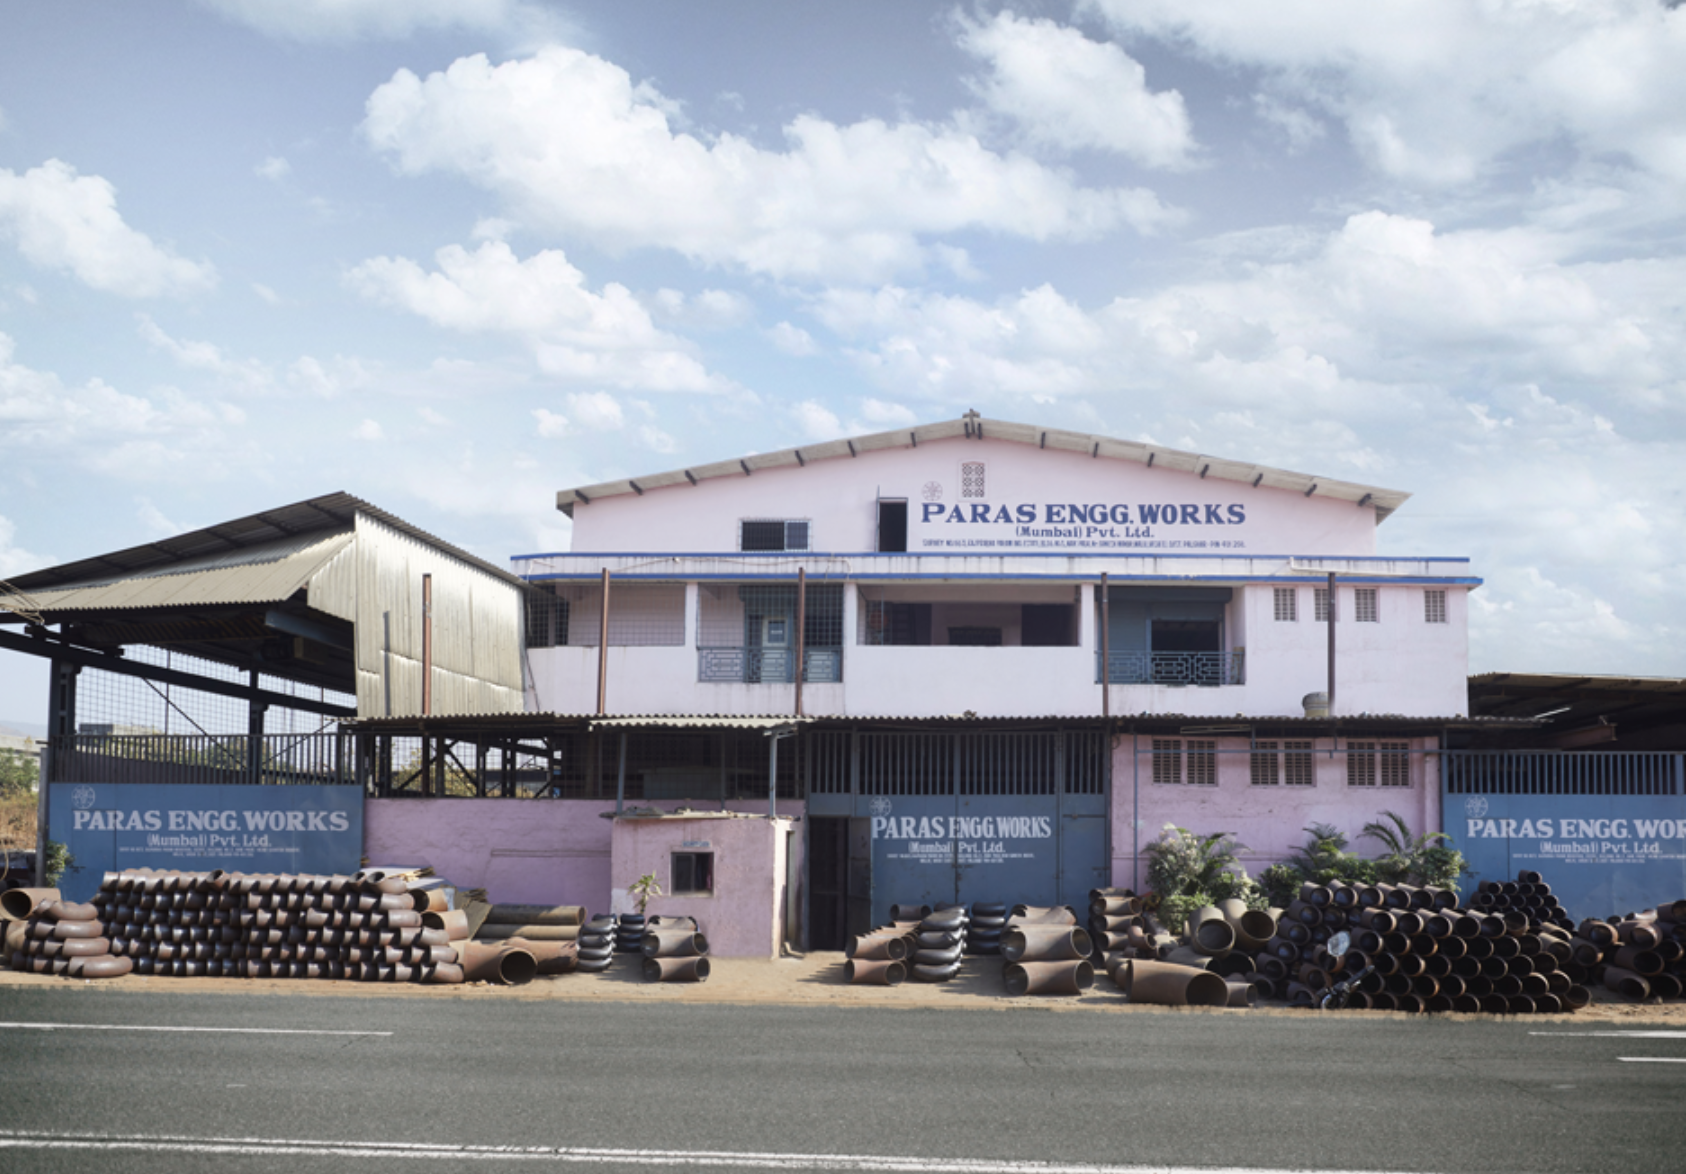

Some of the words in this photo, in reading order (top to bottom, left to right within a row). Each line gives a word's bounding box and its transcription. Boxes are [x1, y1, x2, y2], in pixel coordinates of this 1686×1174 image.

[921, 502, 1037, 524] PARAS
[1045, 502, 1134, 525] ENGG.
[1138, 503, 1246, 525] WORKS
[1086, 526, 1120, 538] Pvt.
[1125, 526, 1154, 538] Ltd.
[73, 810, 162, 831] PARAS
[168, 810, 241, 831] ENGG.
[242, 811, 349, 831] WORKS
[872, 816, 945, 838] PARAS
[996, 817, 1051, 838] WORKS
[1467, 819, 1554, 839] PARAS
[1559, 819, 1632, 839] ENGG.
[210, 834, 240, 848] Pvt.
[243, 834, 272, 848] Ltd.
[958, 841, 981, 853] Pvt.
[983, 841, 1006, 853] Ltd.
[1602, 841, 1630, 853] Pvt.
[1633, 841, 1663, 854] Ltd.
